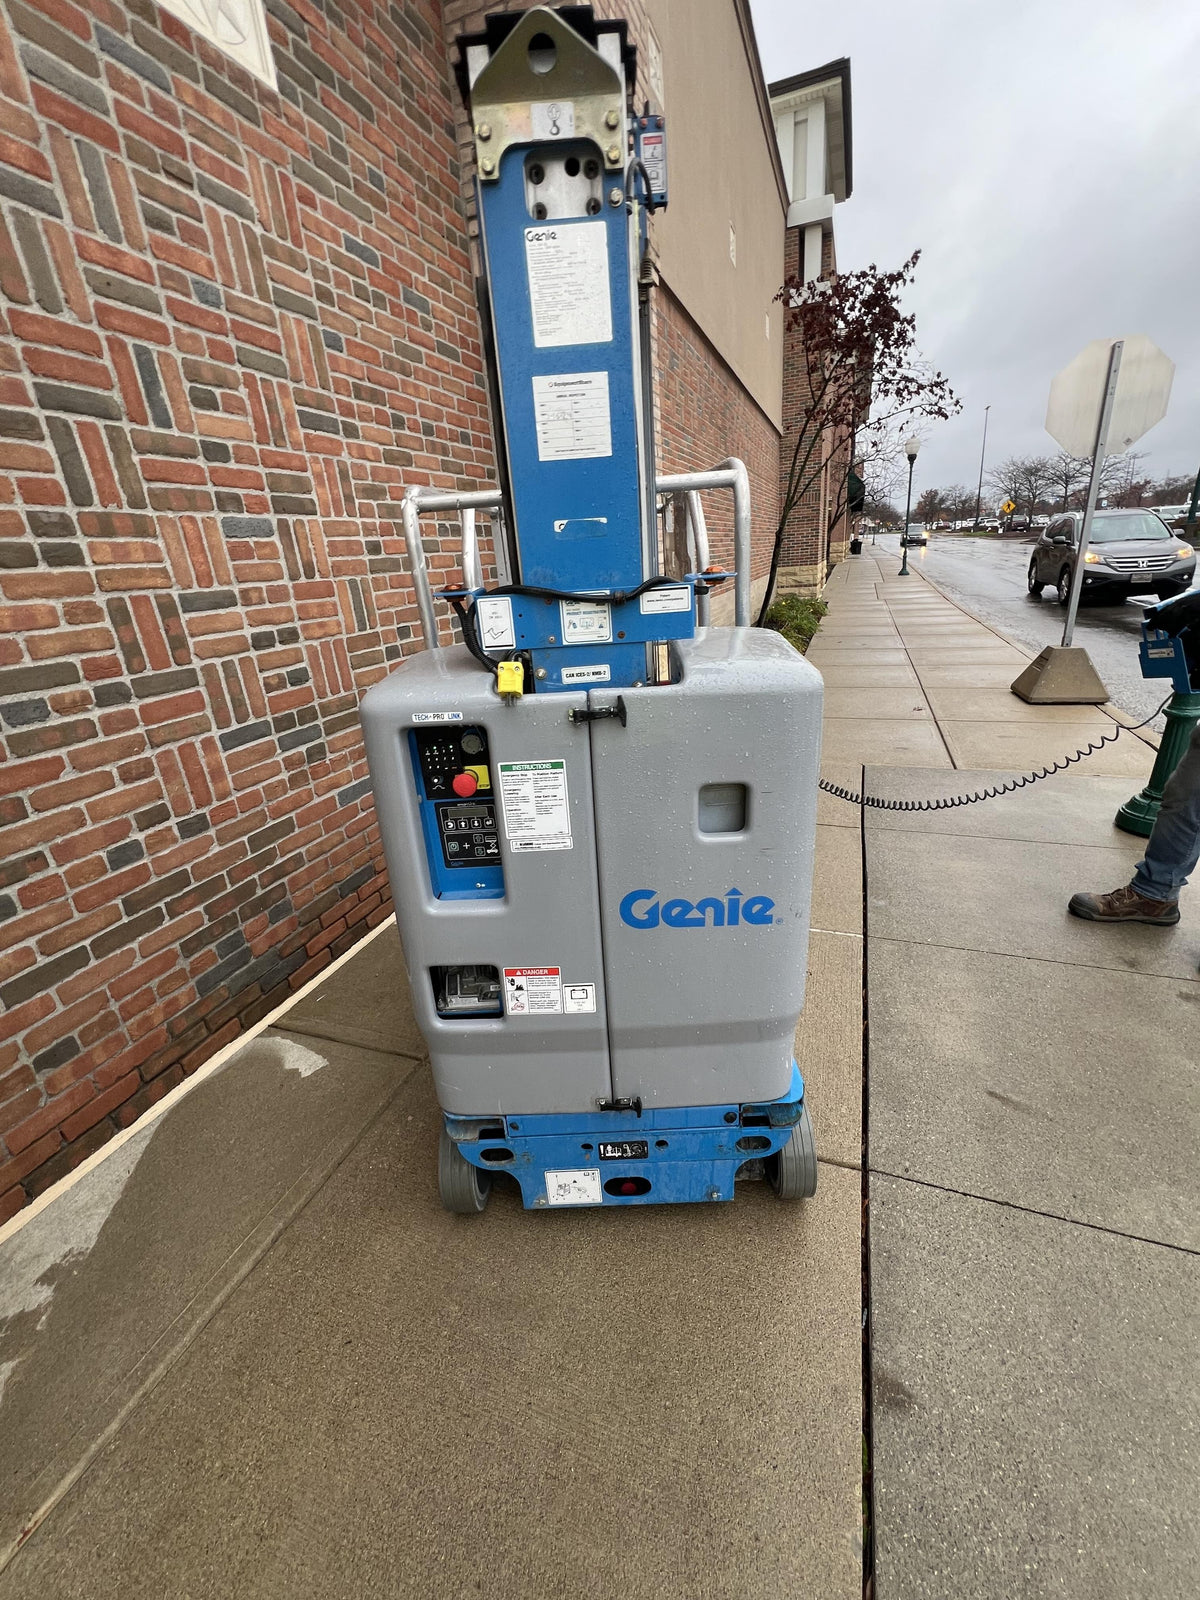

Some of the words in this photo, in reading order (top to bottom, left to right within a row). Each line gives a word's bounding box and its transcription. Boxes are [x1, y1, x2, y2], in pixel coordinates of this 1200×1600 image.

[526, 229, 557, 242] Genie
[447, 712, 462, 720] LINK
[619, 887, 776, 930] Genie
[522, 968, 549, 976] DANGER
